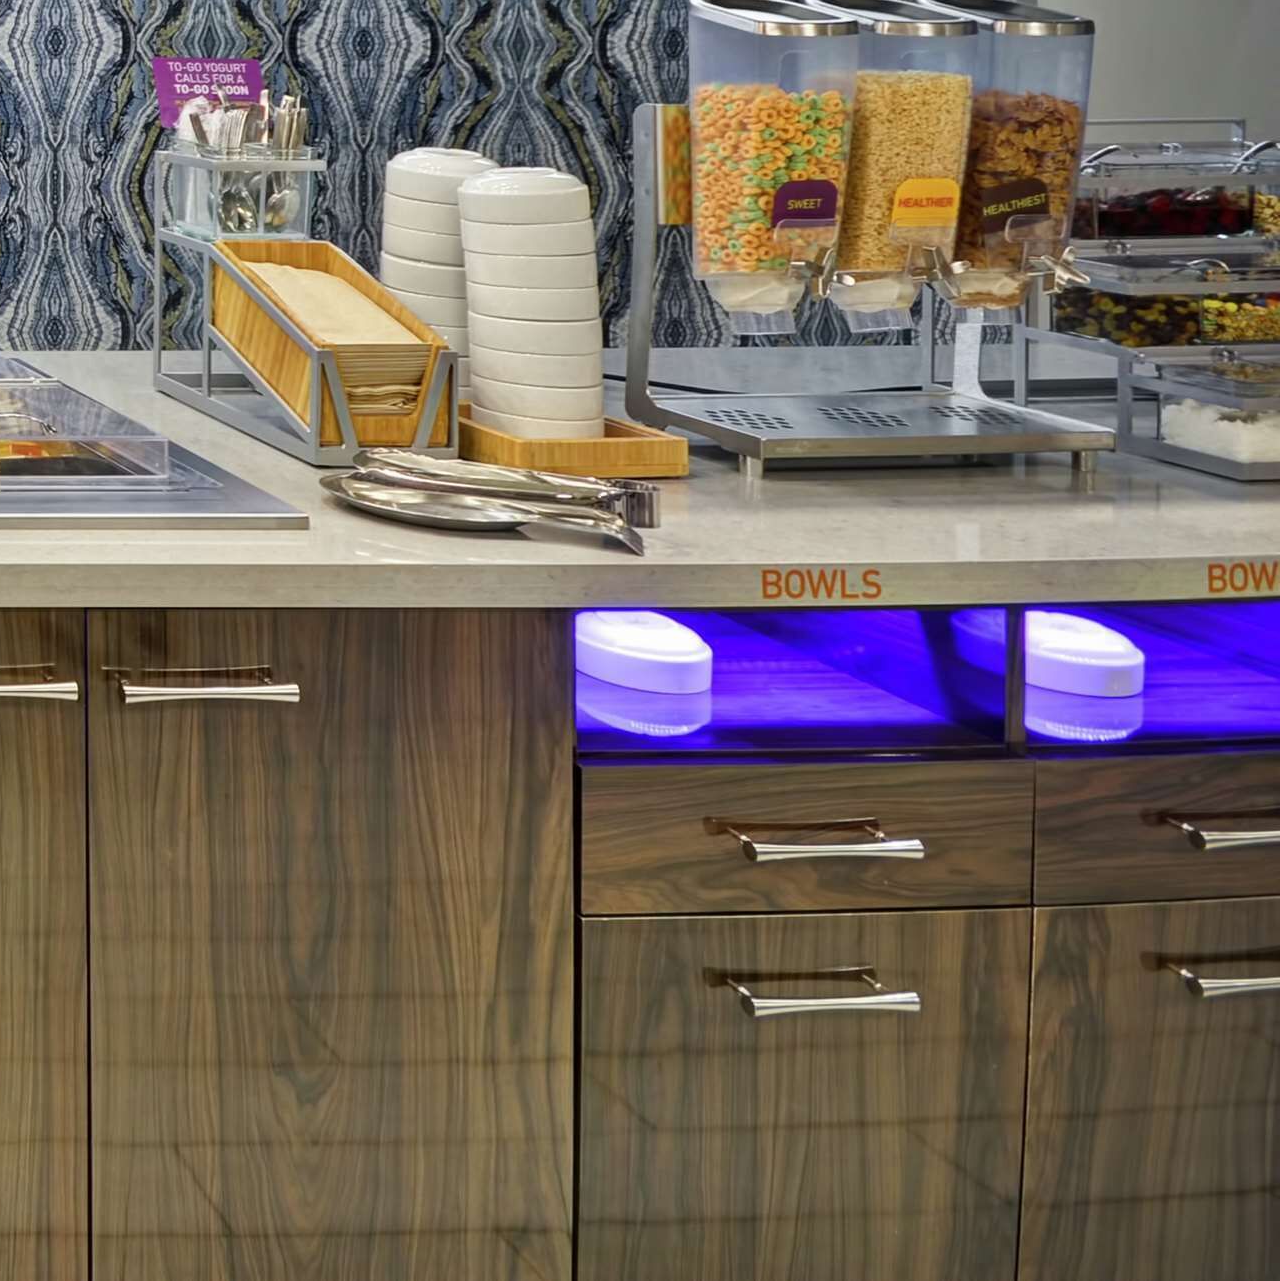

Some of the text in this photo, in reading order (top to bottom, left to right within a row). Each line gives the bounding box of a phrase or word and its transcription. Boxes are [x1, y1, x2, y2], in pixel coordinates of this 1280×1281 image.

[167, 61, 247, 74] TO-GO YOGURT
[175, 73, 246, 85] CALLS FOR A
[174, 84, 249, 96] TO-GO SOON
[787, 198, 823, 210] SWEET
[898, 196, 954, 208] HEALTHIER
[983, 193, 1047, 216] HEALTHIEST
[1207, 561, 1279, 593] BOW
[761, 569, 882, 599] BOWLS
